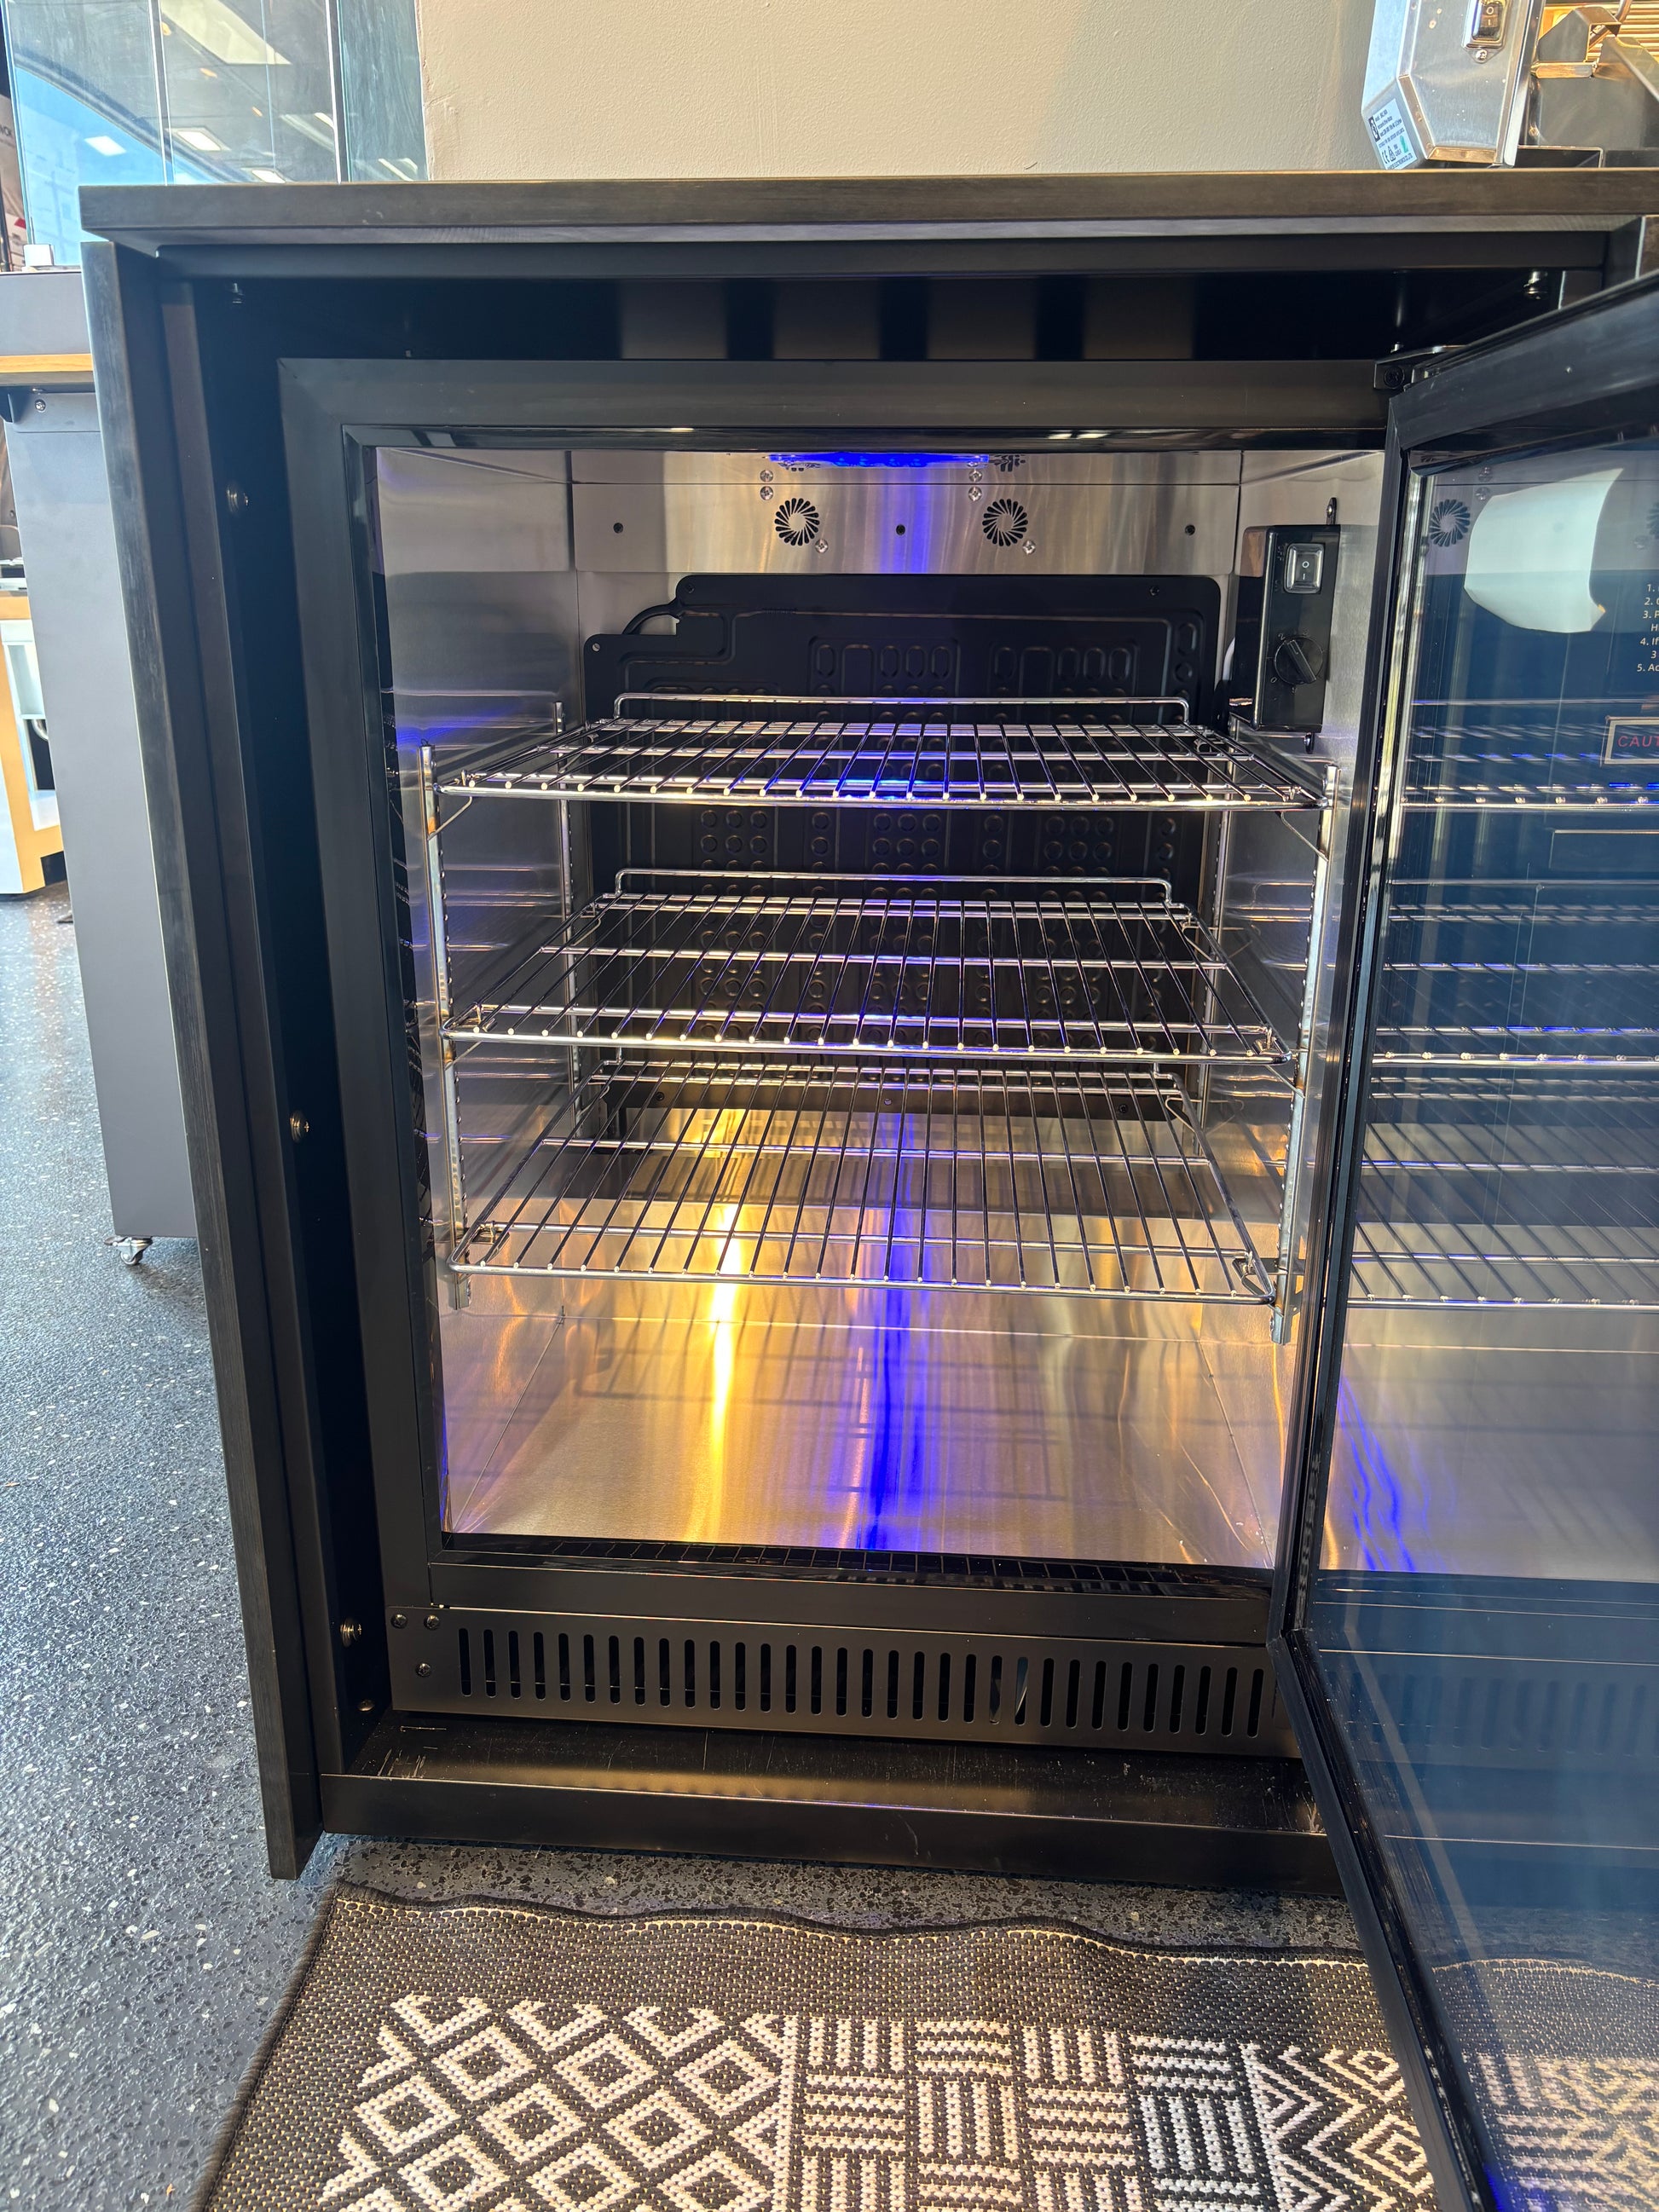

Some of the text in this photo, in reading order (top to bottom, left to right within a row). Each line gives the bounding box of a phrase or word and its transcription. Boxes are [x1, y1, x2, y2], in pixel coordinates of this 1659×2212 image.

[1647, 584, 1655, 592] 1.
[1644, 597, 1653, 605] 2.
[1643, 609, 1651, 619] 3.
[1639, 637, 1649, 646] 4.
[1637, 663, 1645, 673] 5.
